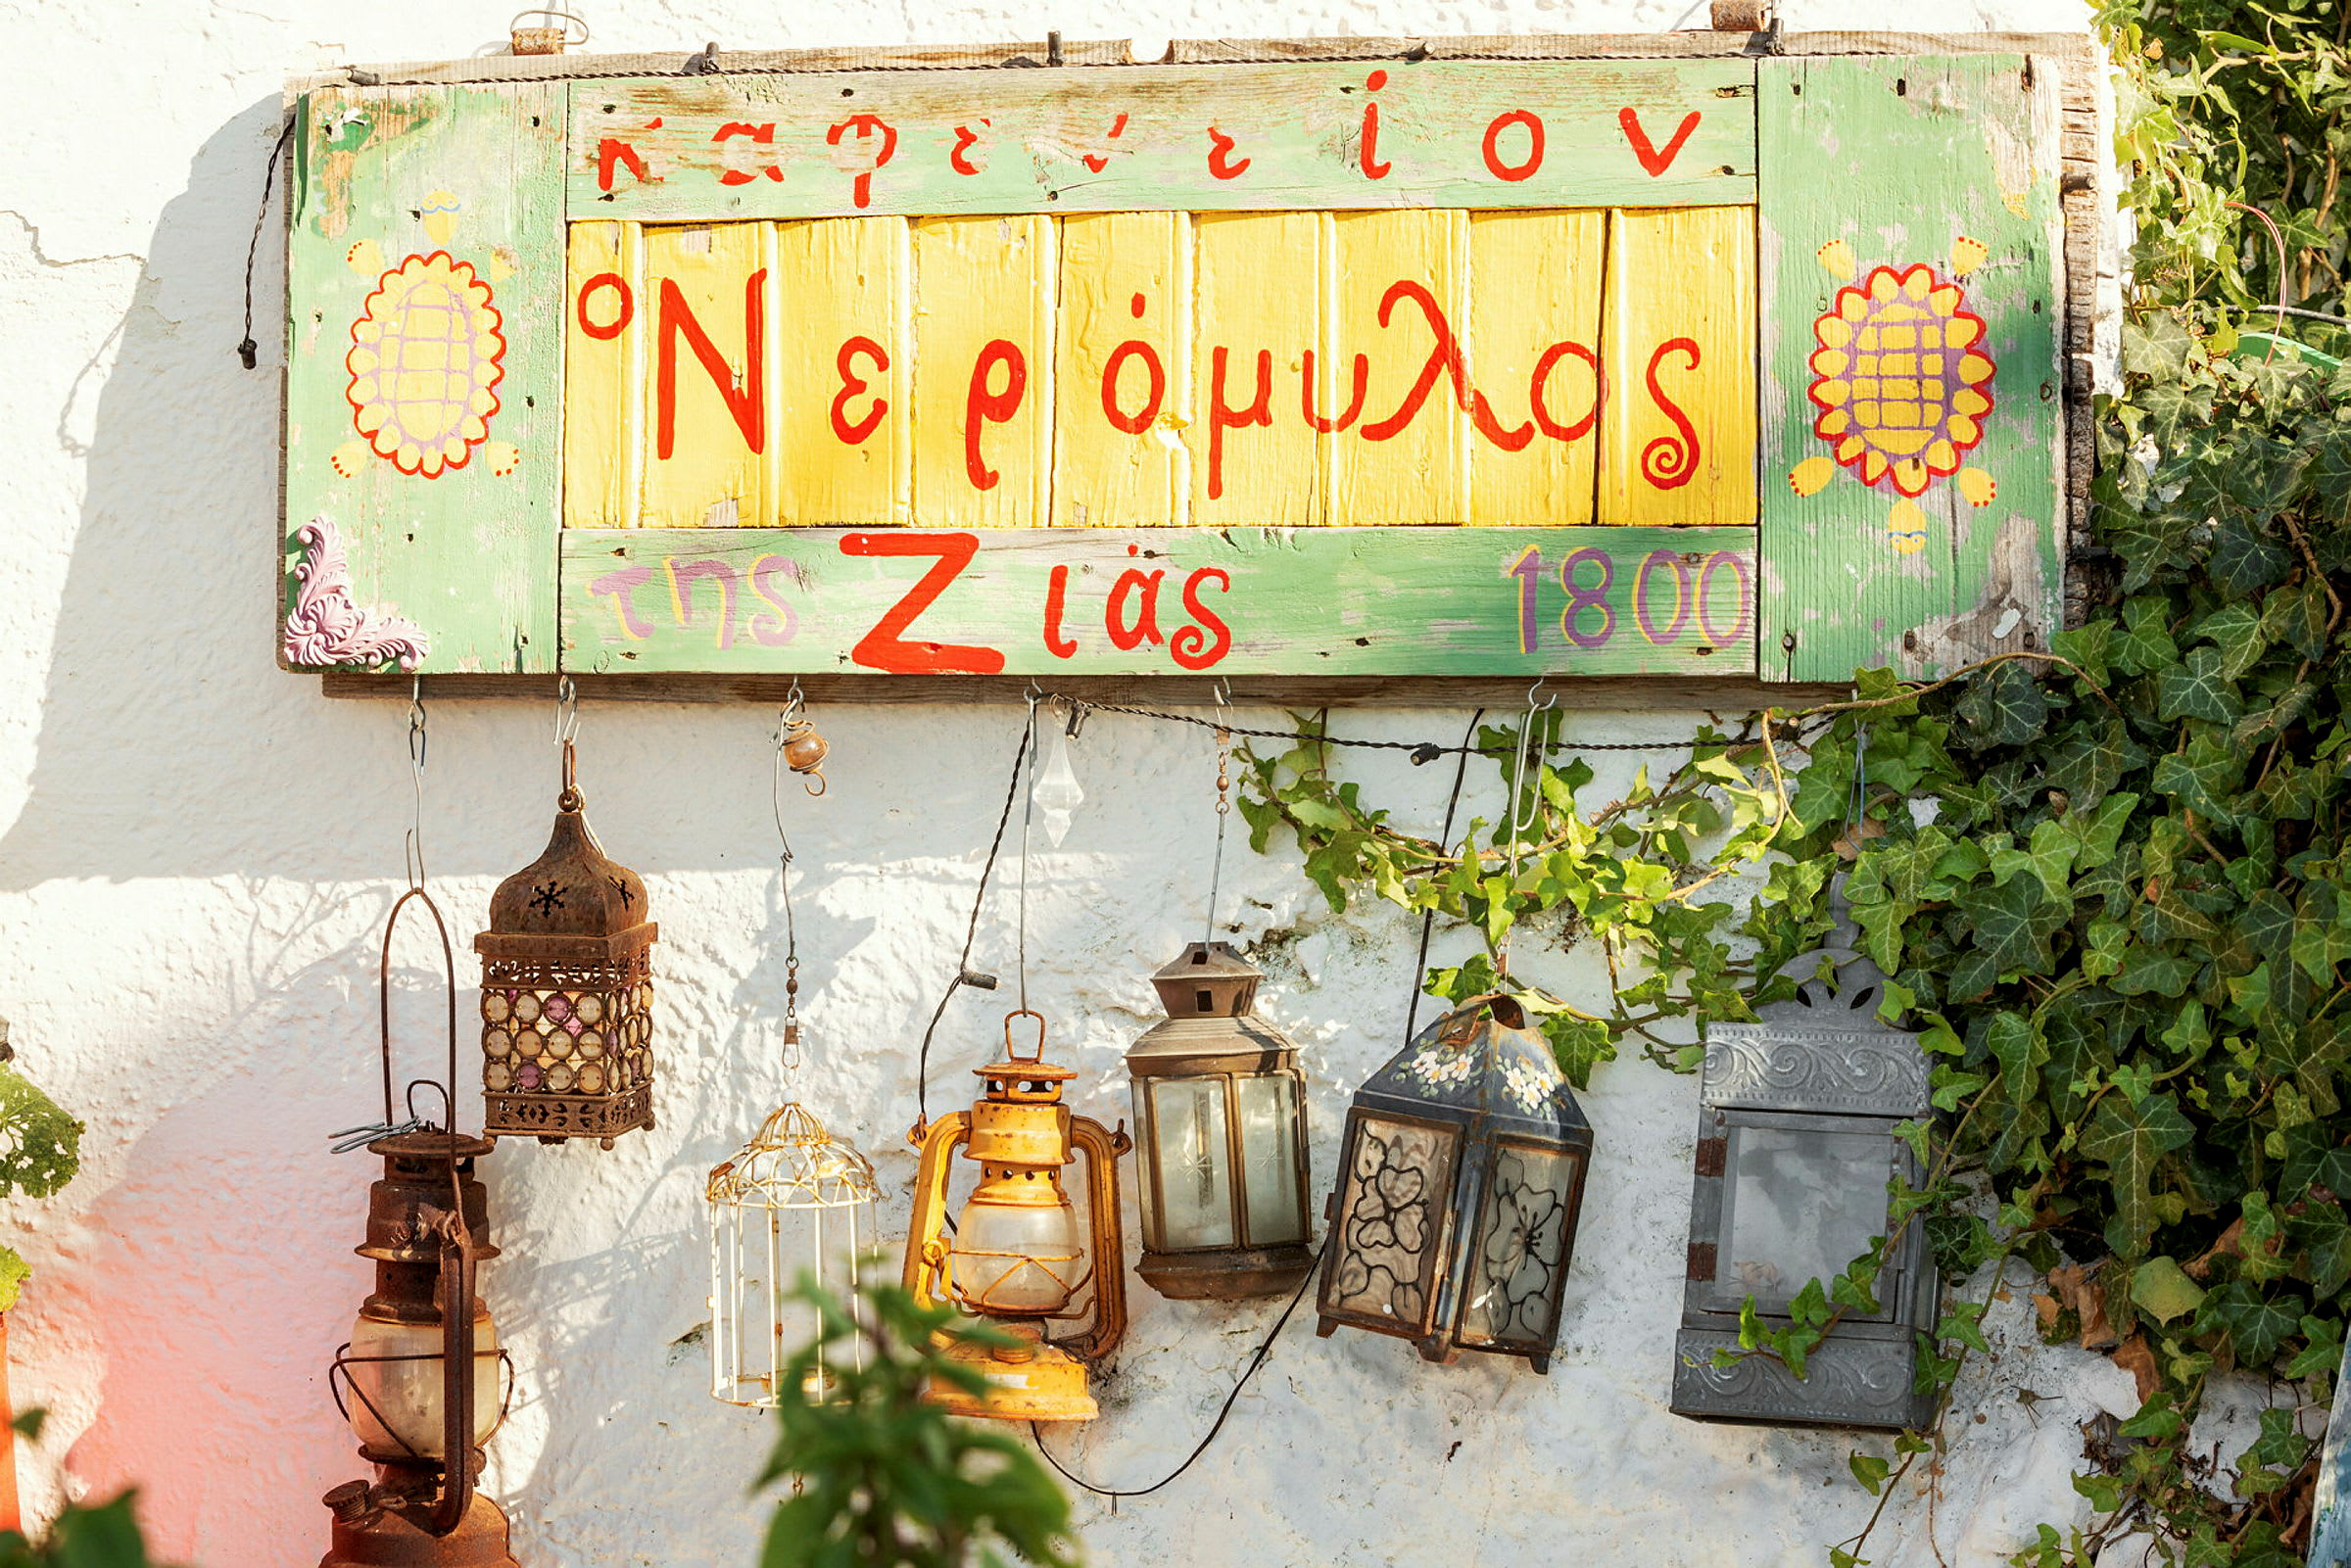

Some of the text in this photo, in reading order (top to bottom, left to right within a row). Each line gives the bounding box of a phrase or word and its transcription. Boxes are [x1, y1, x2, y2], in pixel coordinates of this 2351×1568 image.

[657, 267, 1701, 499] Νερόμυλος
[587, 552, 799, 650] της
[1510, 544, 1751, 654] 1800
